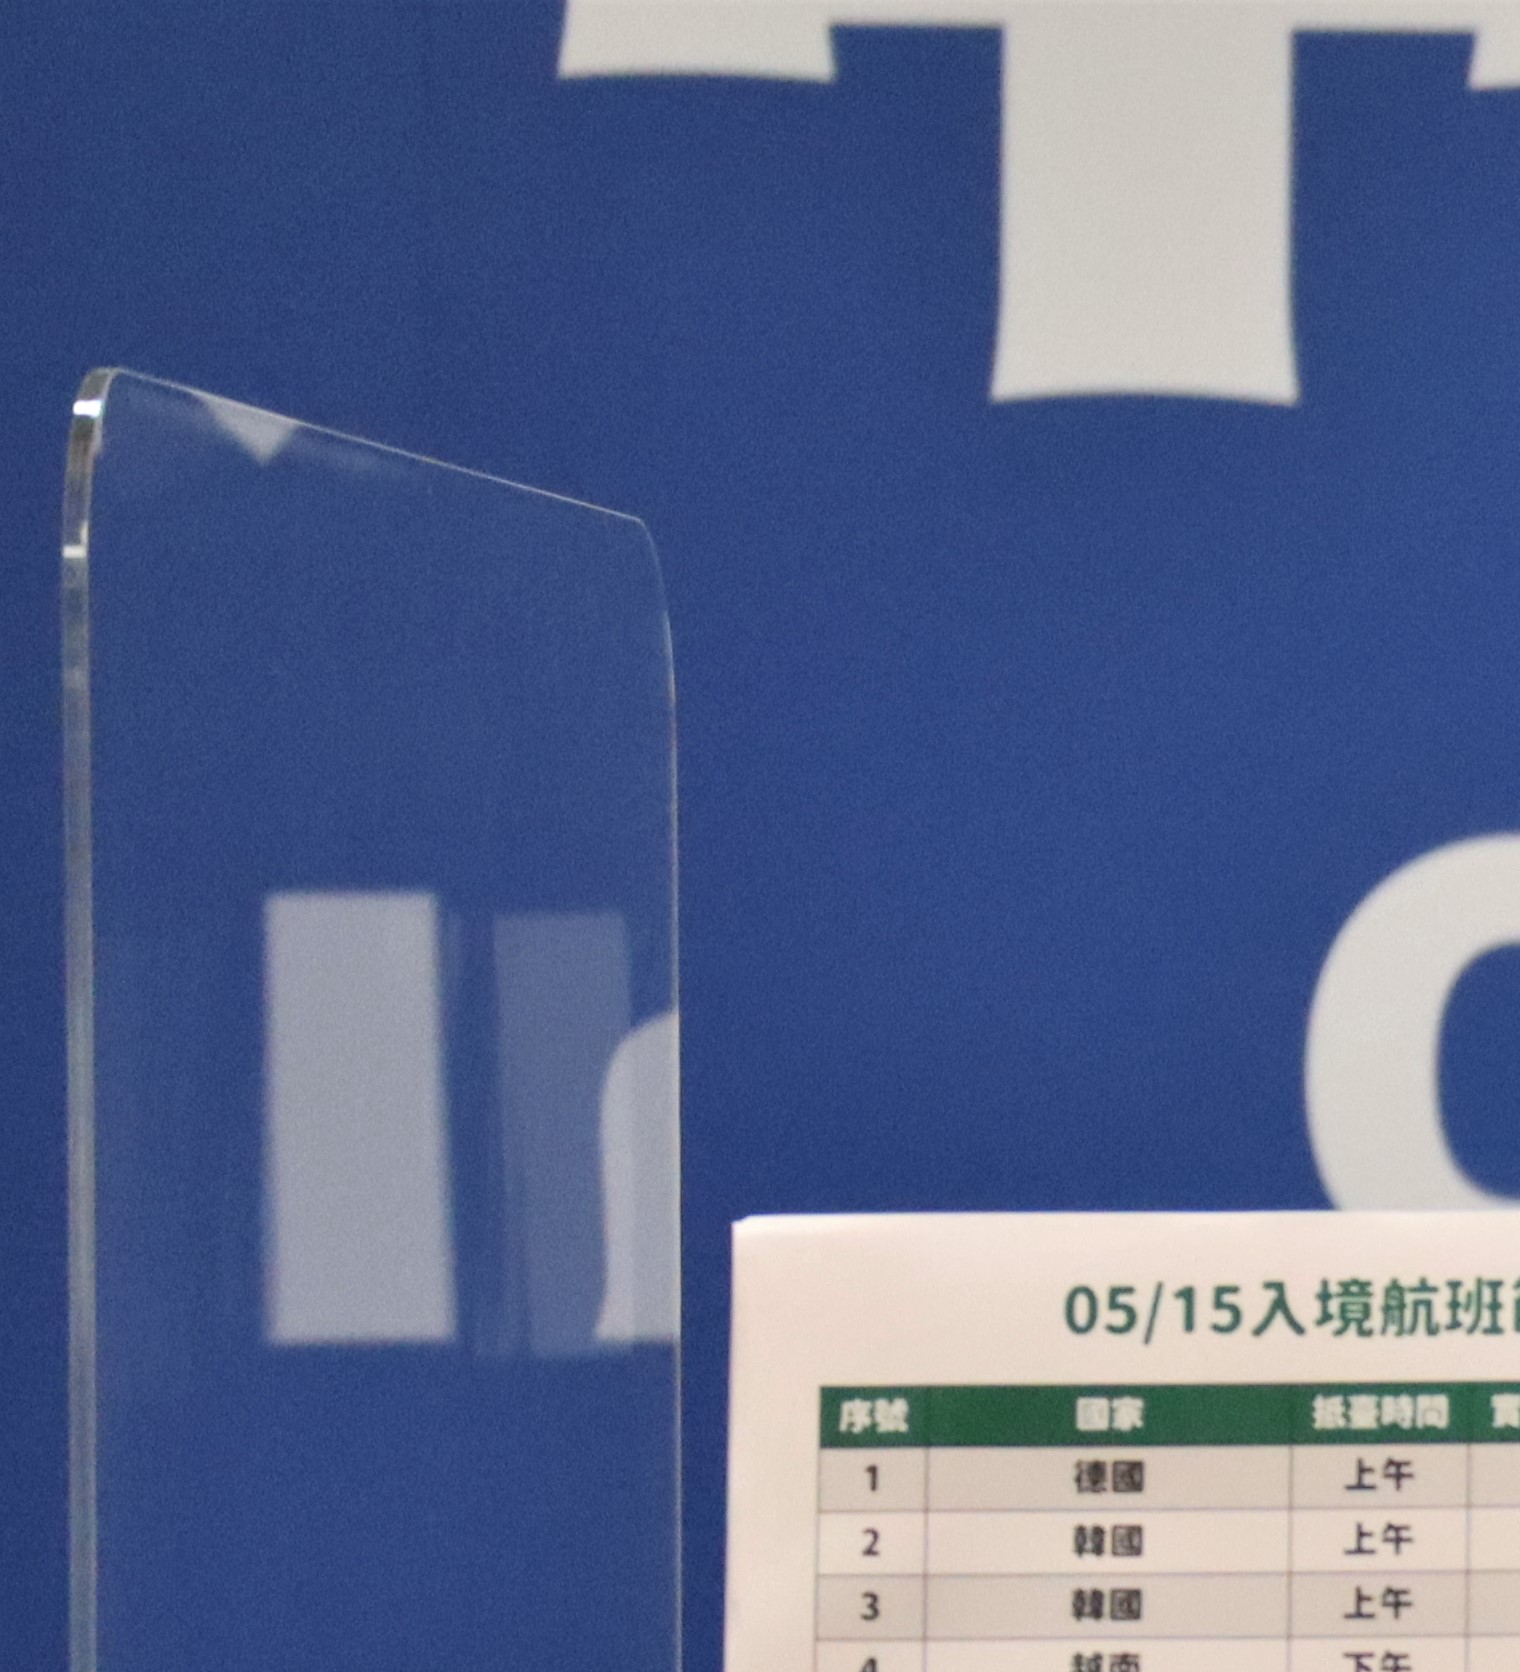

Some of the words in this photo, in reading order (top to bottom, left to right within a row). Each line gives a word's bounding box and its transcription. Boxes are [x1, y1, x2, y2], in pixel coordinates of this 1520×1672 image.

[839, 1398, 909, 1433] 序號
[1076, 1396, 1144, 1431] 國家
[1344, 1457, 1414, 1492] 上午
[862, 1527, 880, 1557] 2
[1073, 1524, 1144, 1558] 韓國
[1344, 1522, 1413, 1556] 上午
[860, 1591, 881, 1622] 3
[1071, 1588, 1143, 1622] 韓國
[1343, 1586, 1413, 1620] 上午
